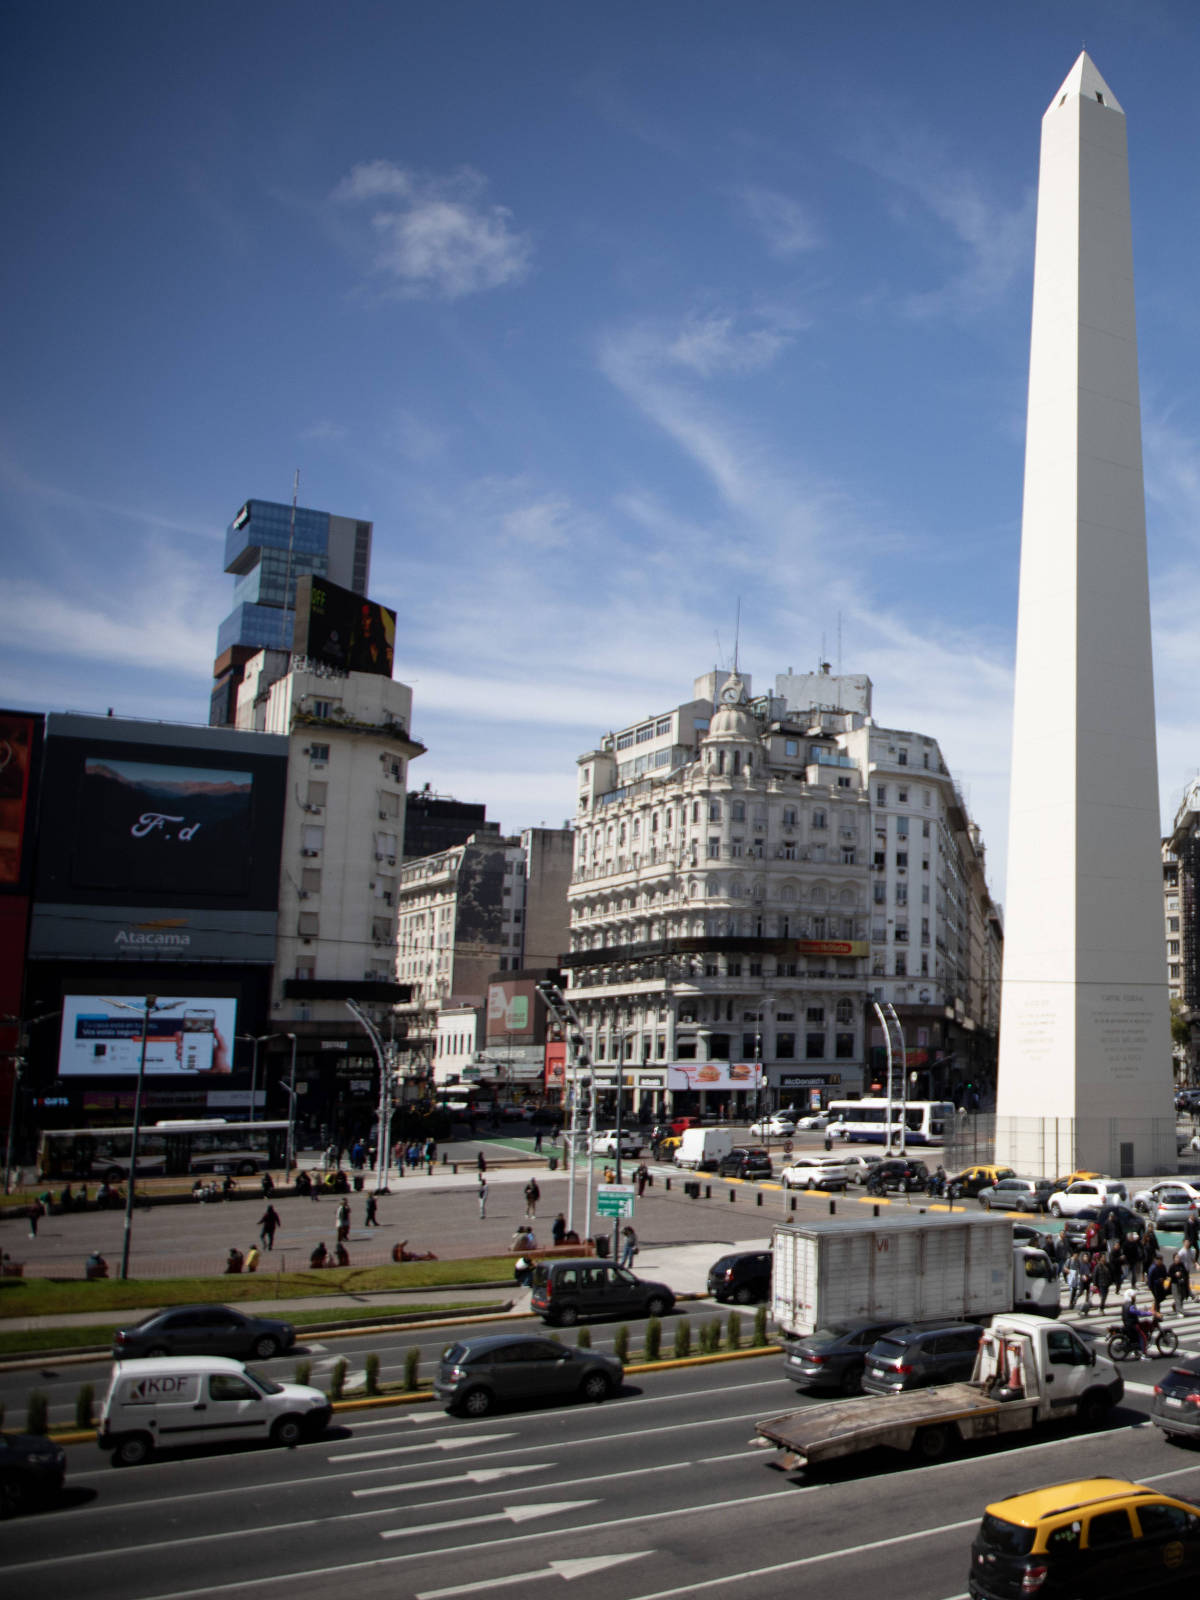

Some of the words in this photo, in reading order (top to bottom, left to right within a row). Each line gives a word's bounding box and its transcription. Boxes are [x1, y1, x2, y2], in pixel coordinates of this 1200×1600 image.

[113, 929, 192, 945] Atacama
[784, 1077, 825, 1086] McDonald's
[148, 1376, 189, 1393] KDF
